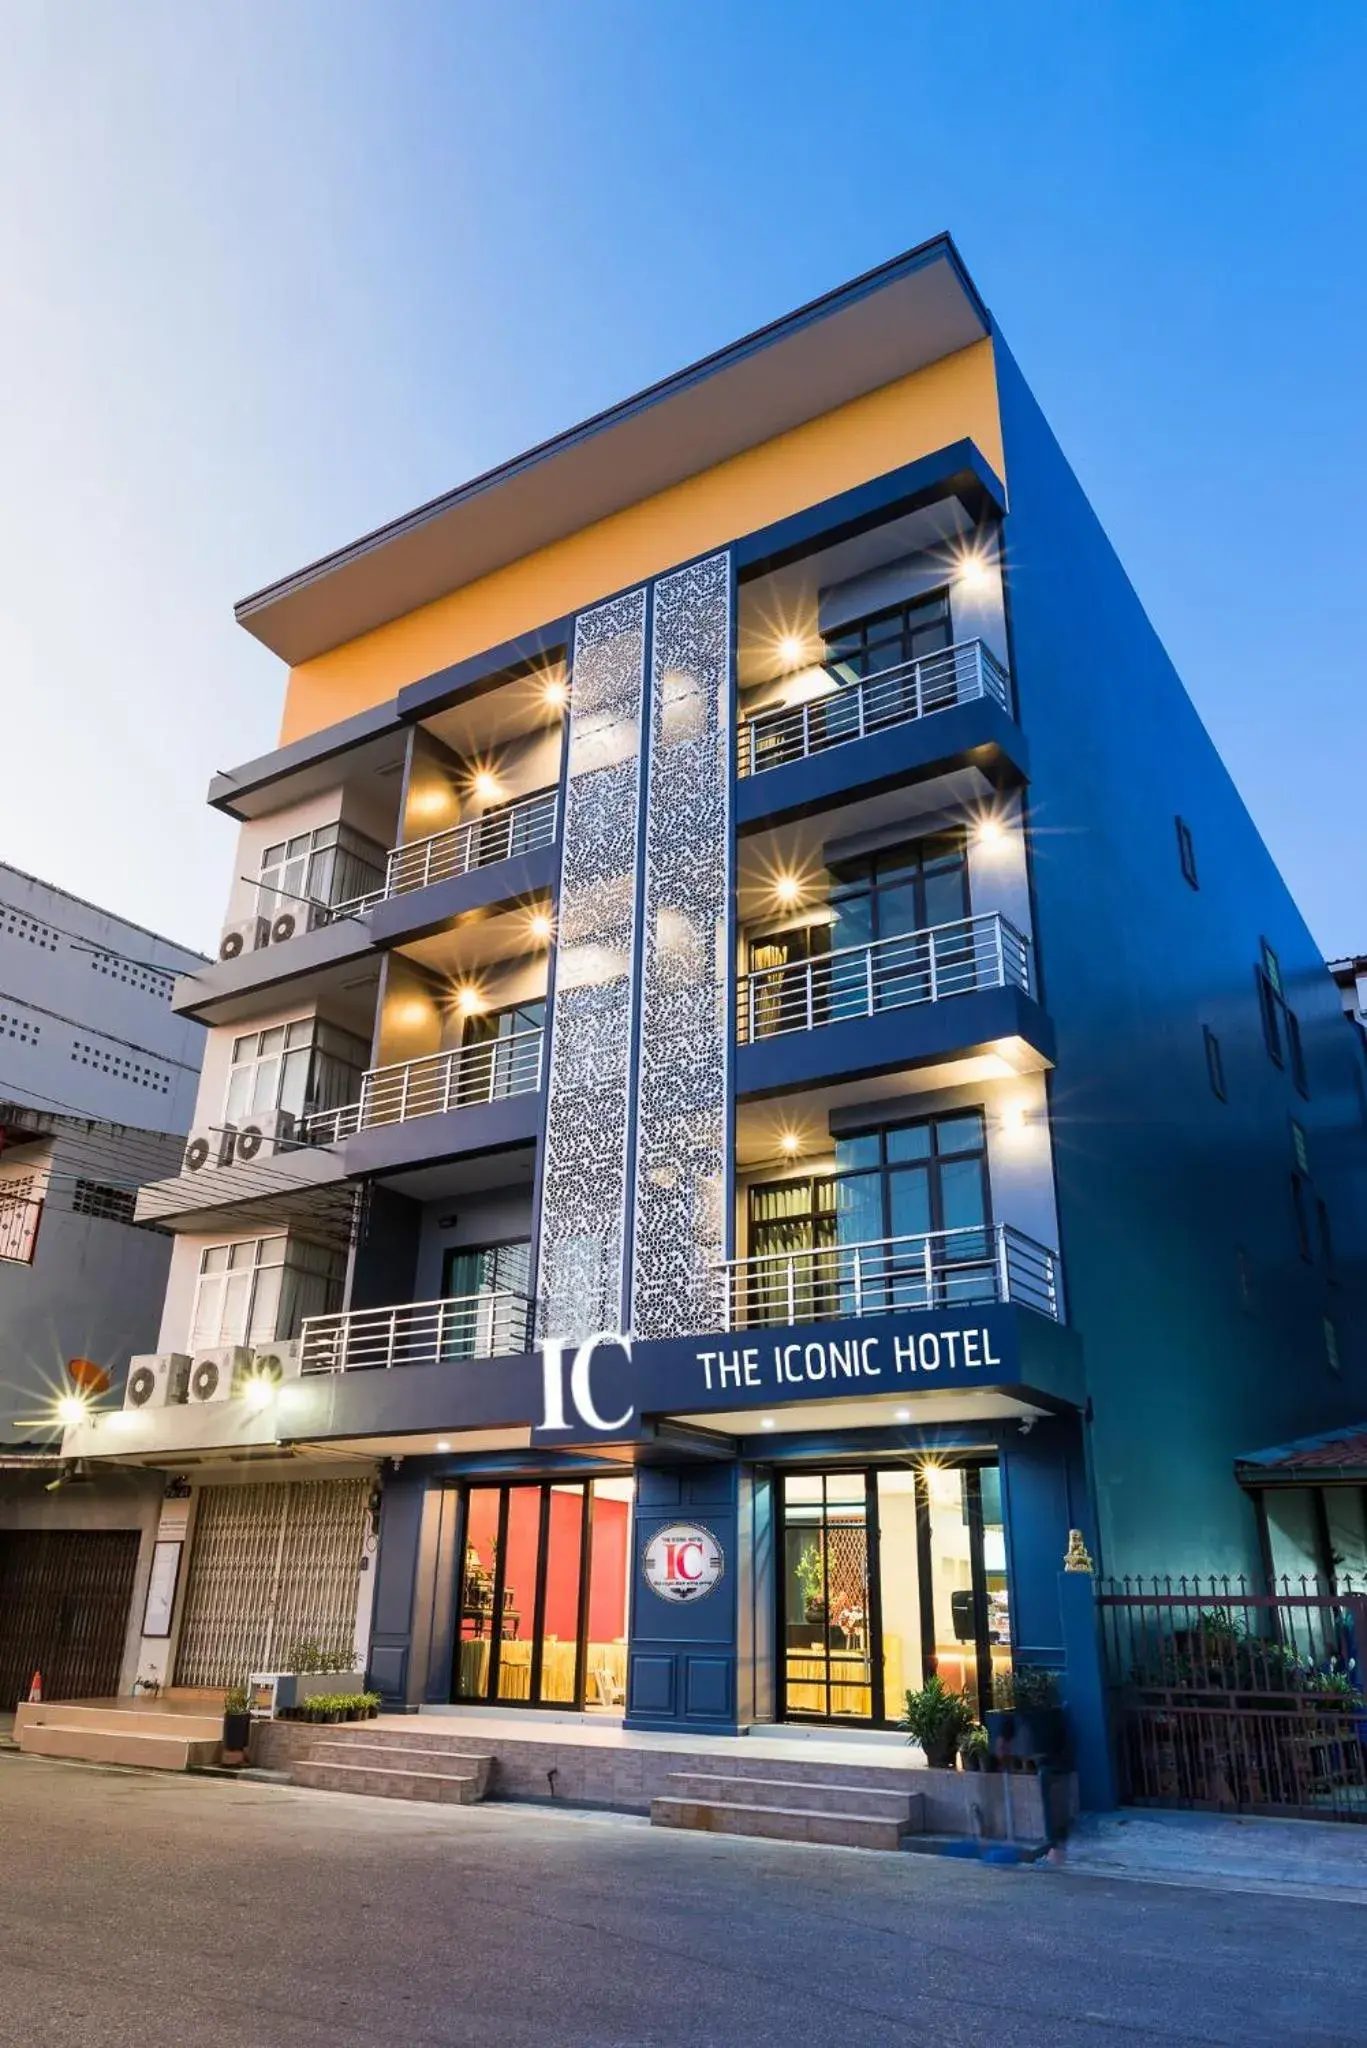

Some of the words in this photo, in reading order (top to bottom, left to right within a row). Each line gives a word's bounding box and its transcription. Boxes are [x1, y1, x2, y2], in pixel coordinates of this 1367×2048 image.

[535, 1332, 634, 1430] IC
[696, 1349, 761, 1389] THE
[774, 1338, 881, 1384] ICONIC
[894, 1328, 1001, 1373] HOTEL
[664, 1542, 703, 1580] IC
